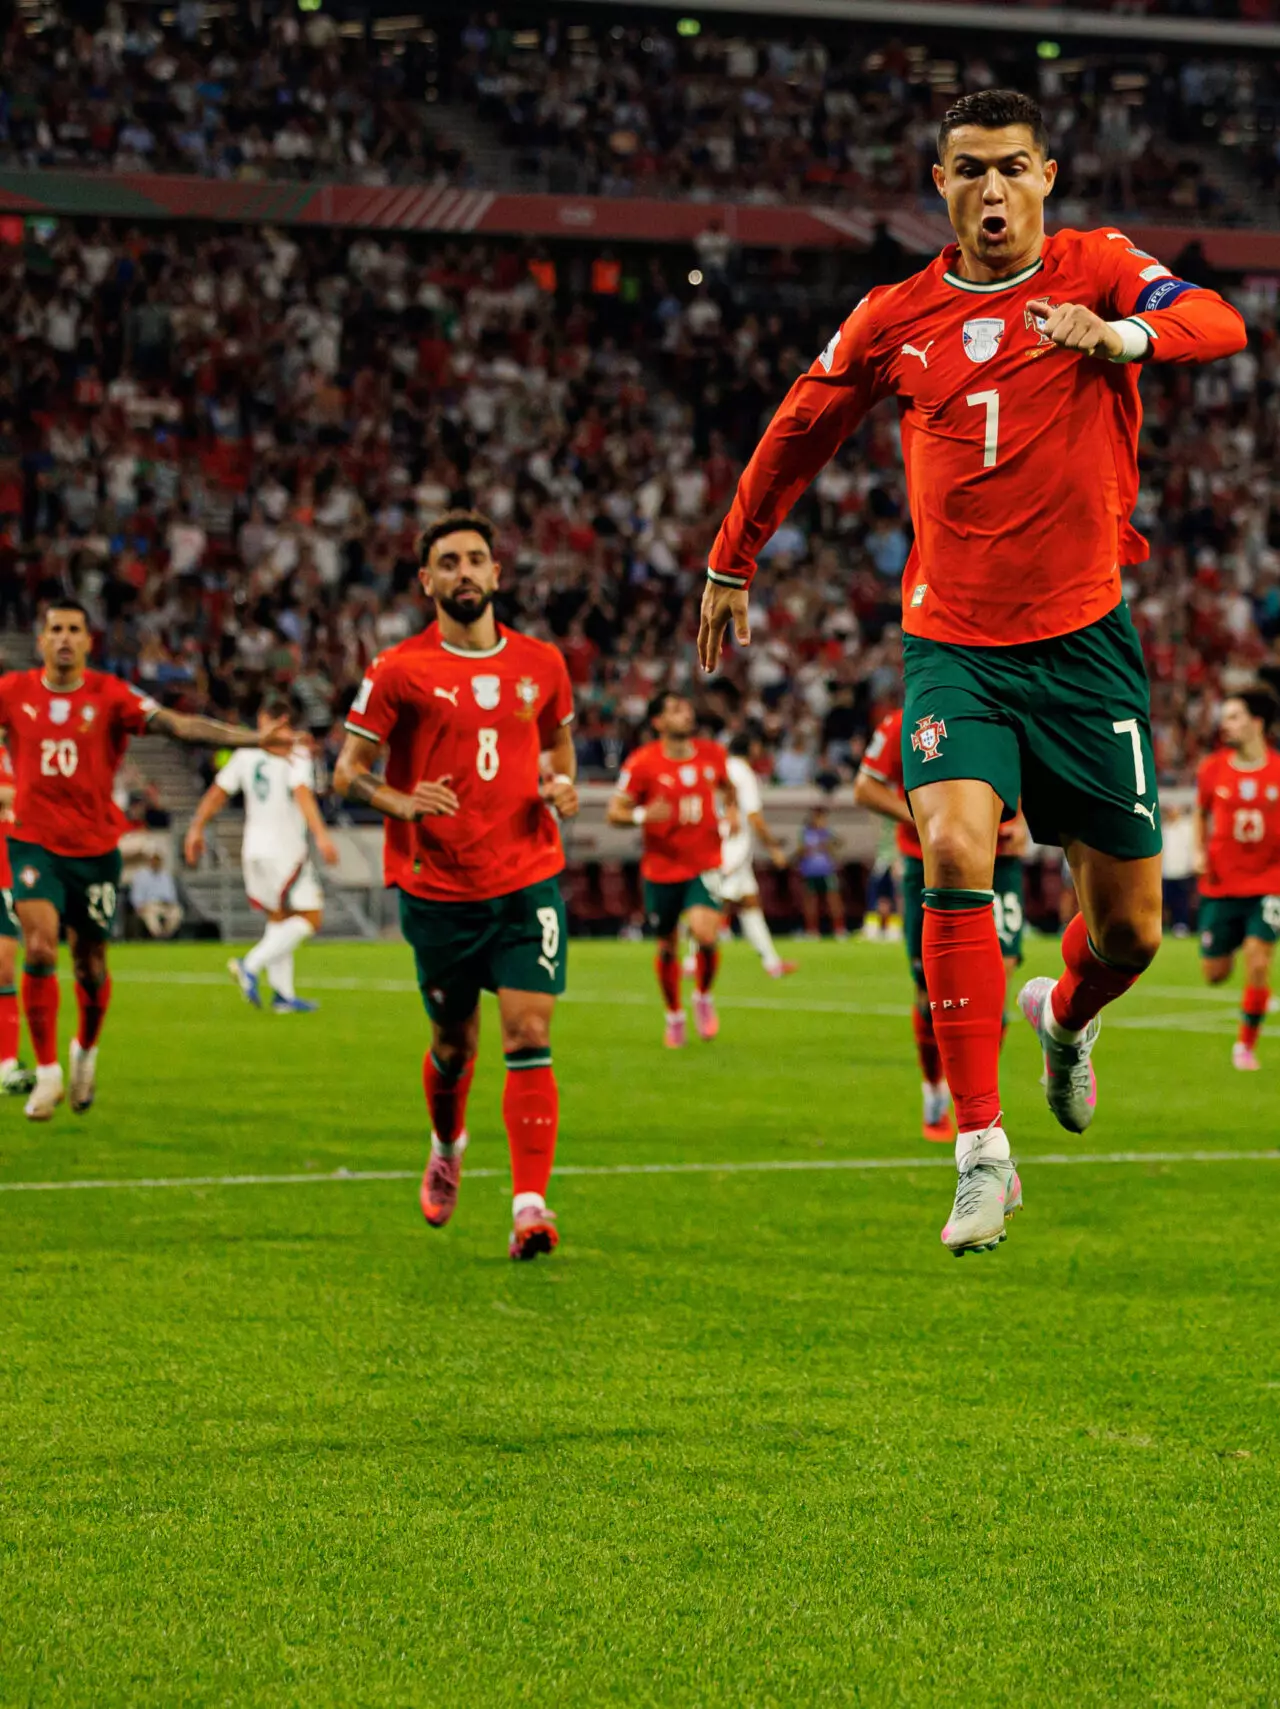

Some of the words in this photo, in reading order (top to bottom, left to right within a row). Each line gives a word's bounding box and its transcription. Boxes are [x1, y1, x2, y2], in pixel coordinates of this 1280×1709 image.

[1146, 281, 1177, 310] SPECT
[966, 389, 1000, 468] 7
[40, 738, 79, 778] 20
[476, 727, 500, 782] 8
[1112, 718, 1147, 796] 7
[536, 906, 560, 959] 8
